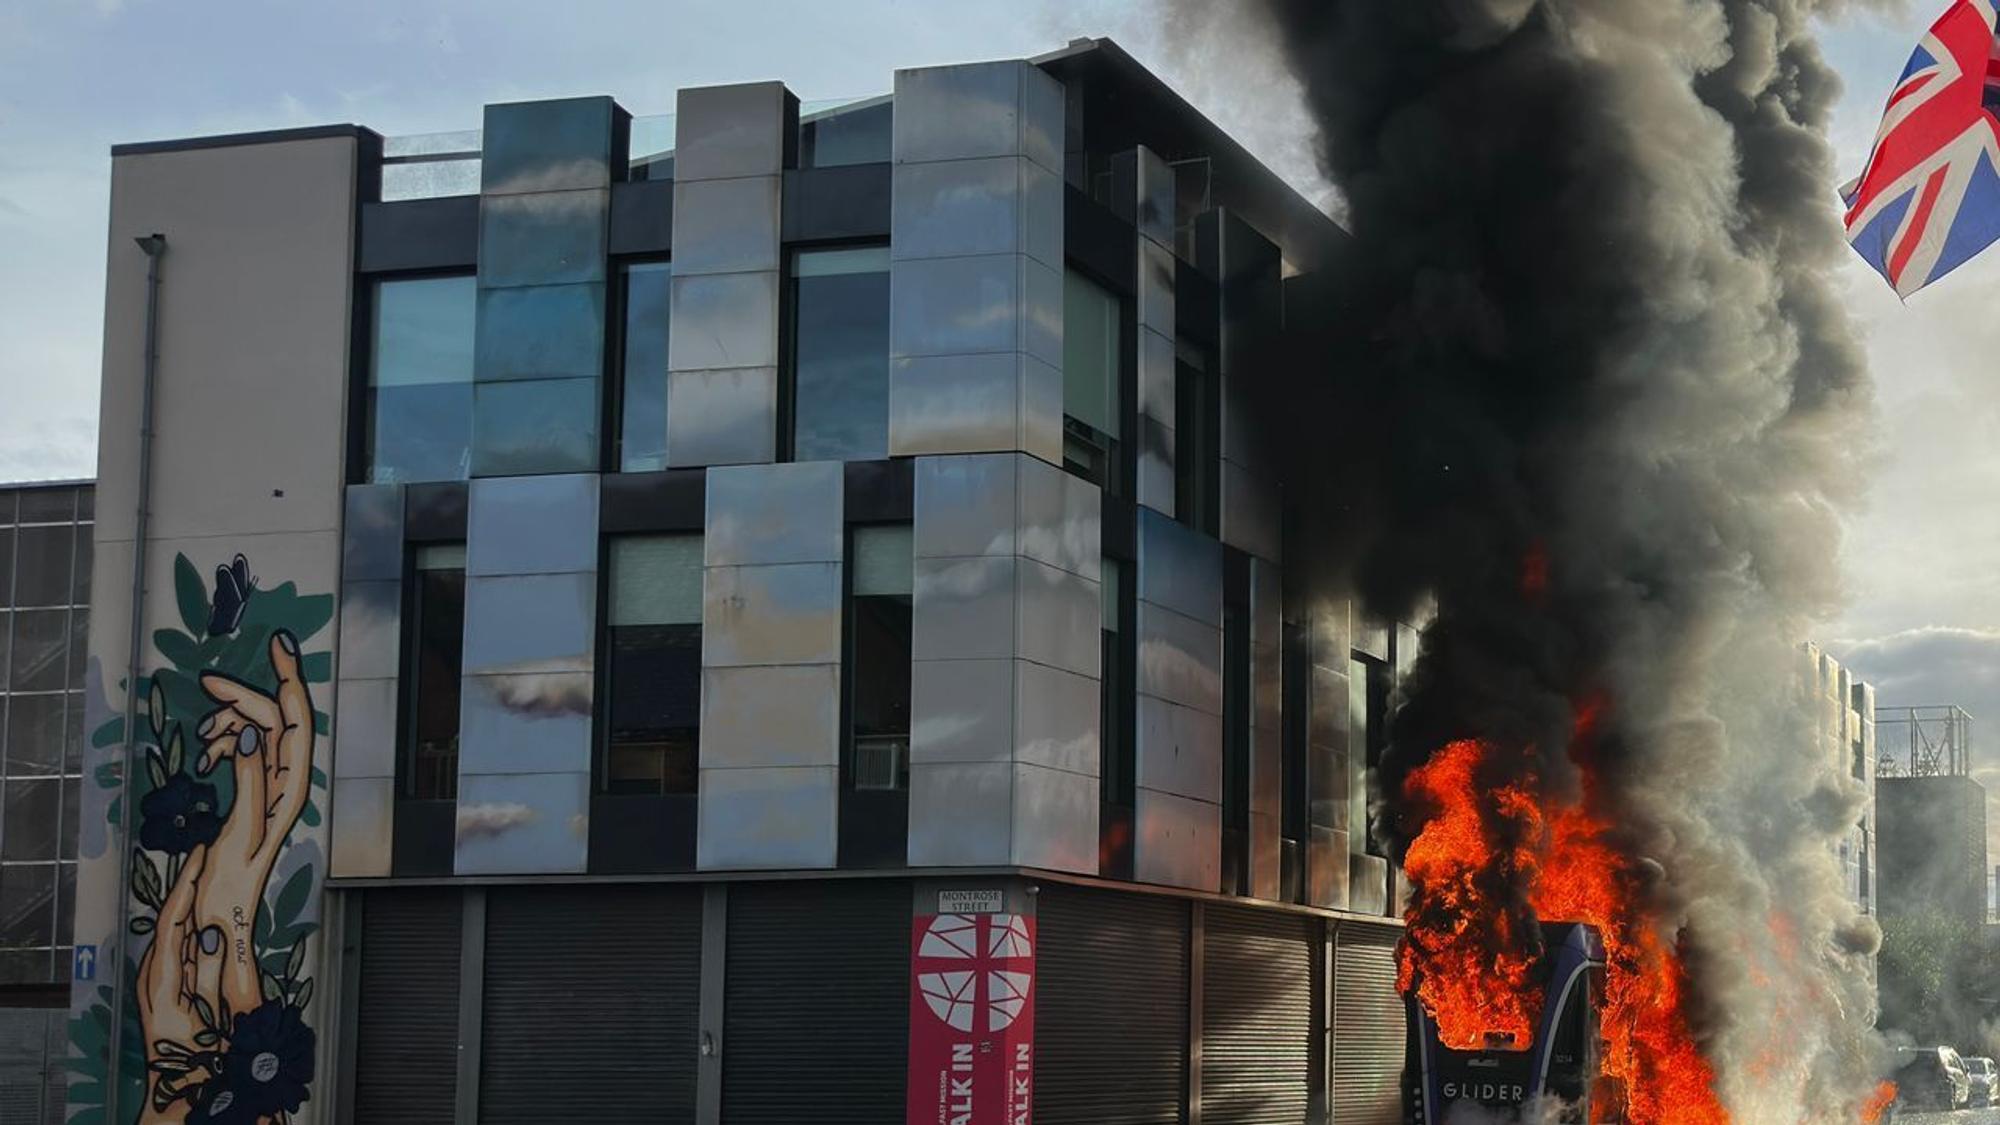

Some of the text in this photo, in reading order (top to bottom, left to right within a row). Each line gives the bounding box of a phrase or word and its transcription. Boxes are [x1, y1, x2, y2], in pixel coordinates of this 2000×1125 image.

[943, 891, 998, 901] MONTROSE
[951, 902, 989, 911] STREET
[952, 1044, 973, 1071] IN
[1016, 1044, 1029, 1070] IN
[1443, 1083, 1523, 1101] GLIDER
